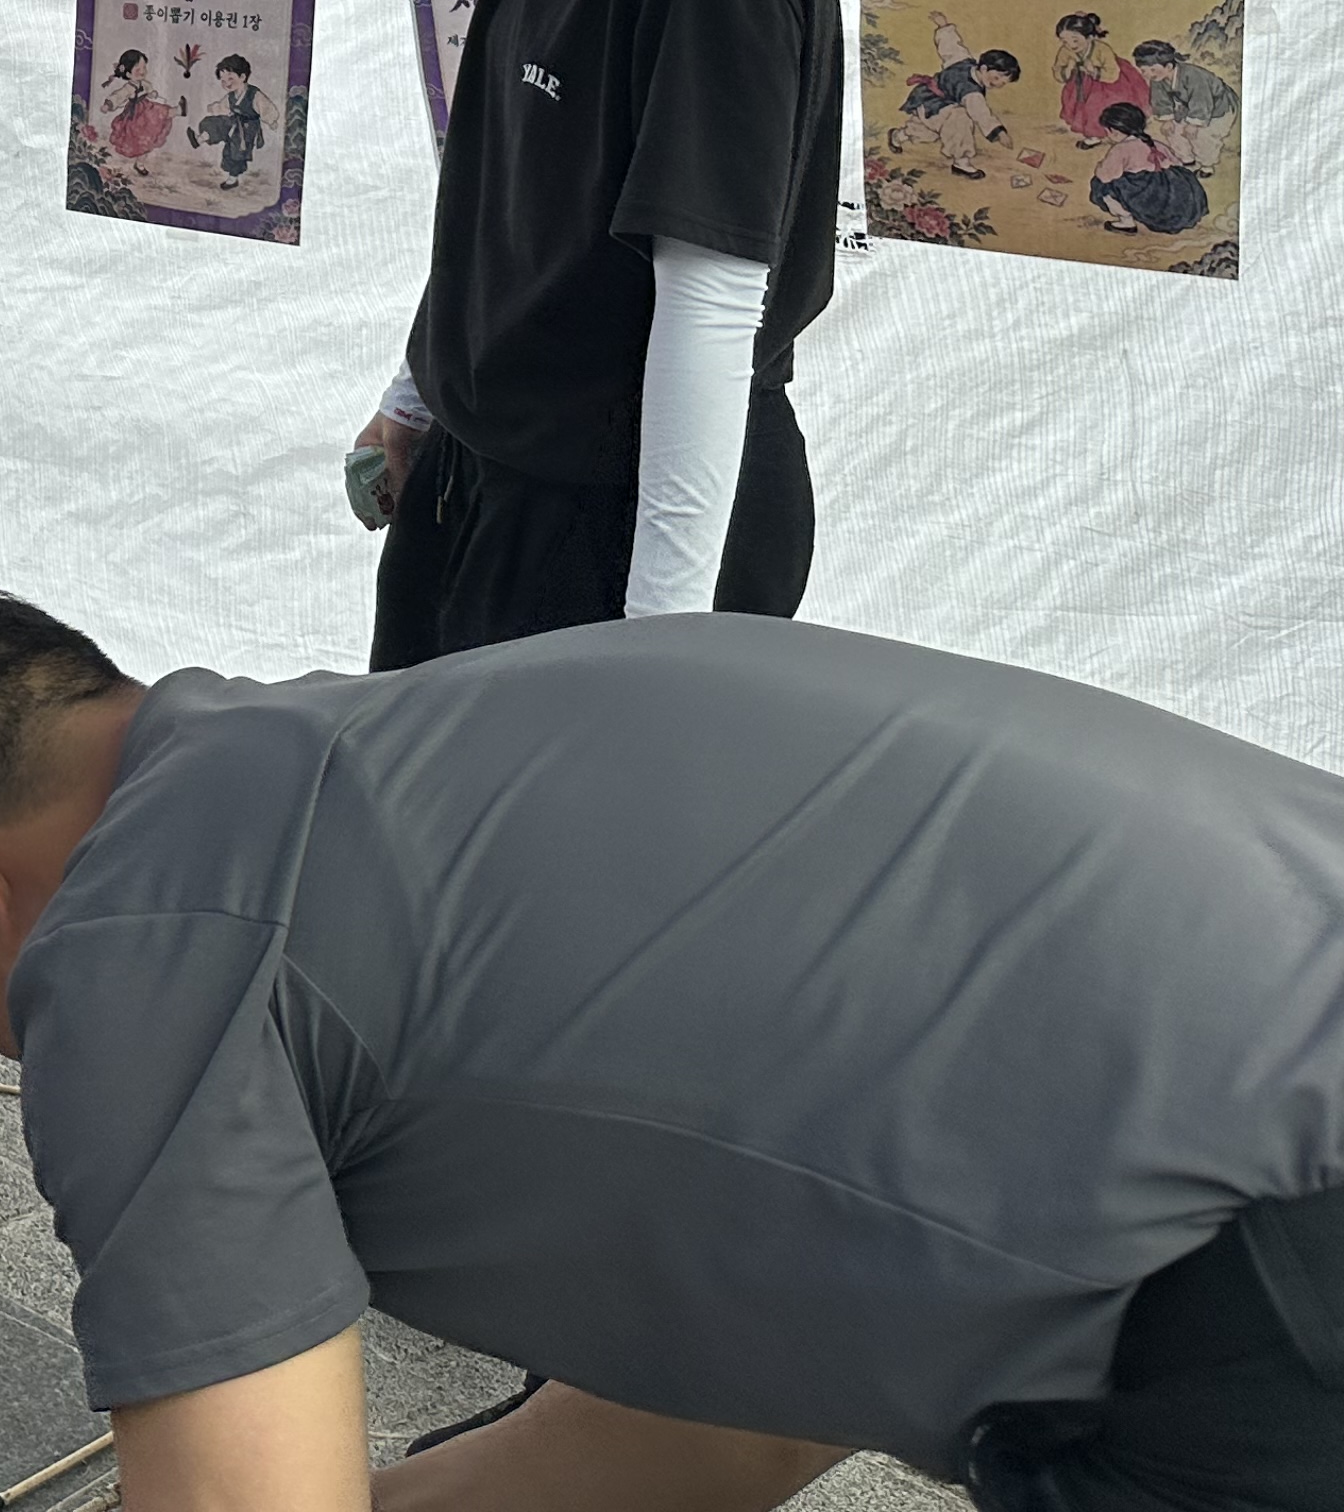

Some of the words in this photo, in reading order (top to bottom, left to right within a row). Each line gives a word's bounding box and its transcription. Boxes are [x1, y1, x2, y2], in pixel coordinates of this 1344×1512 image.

[143, 4, 195, 26] 종이뽑기
[200, 9, 238, 29] 이용권
[242, 14, 262, 32] 1장
